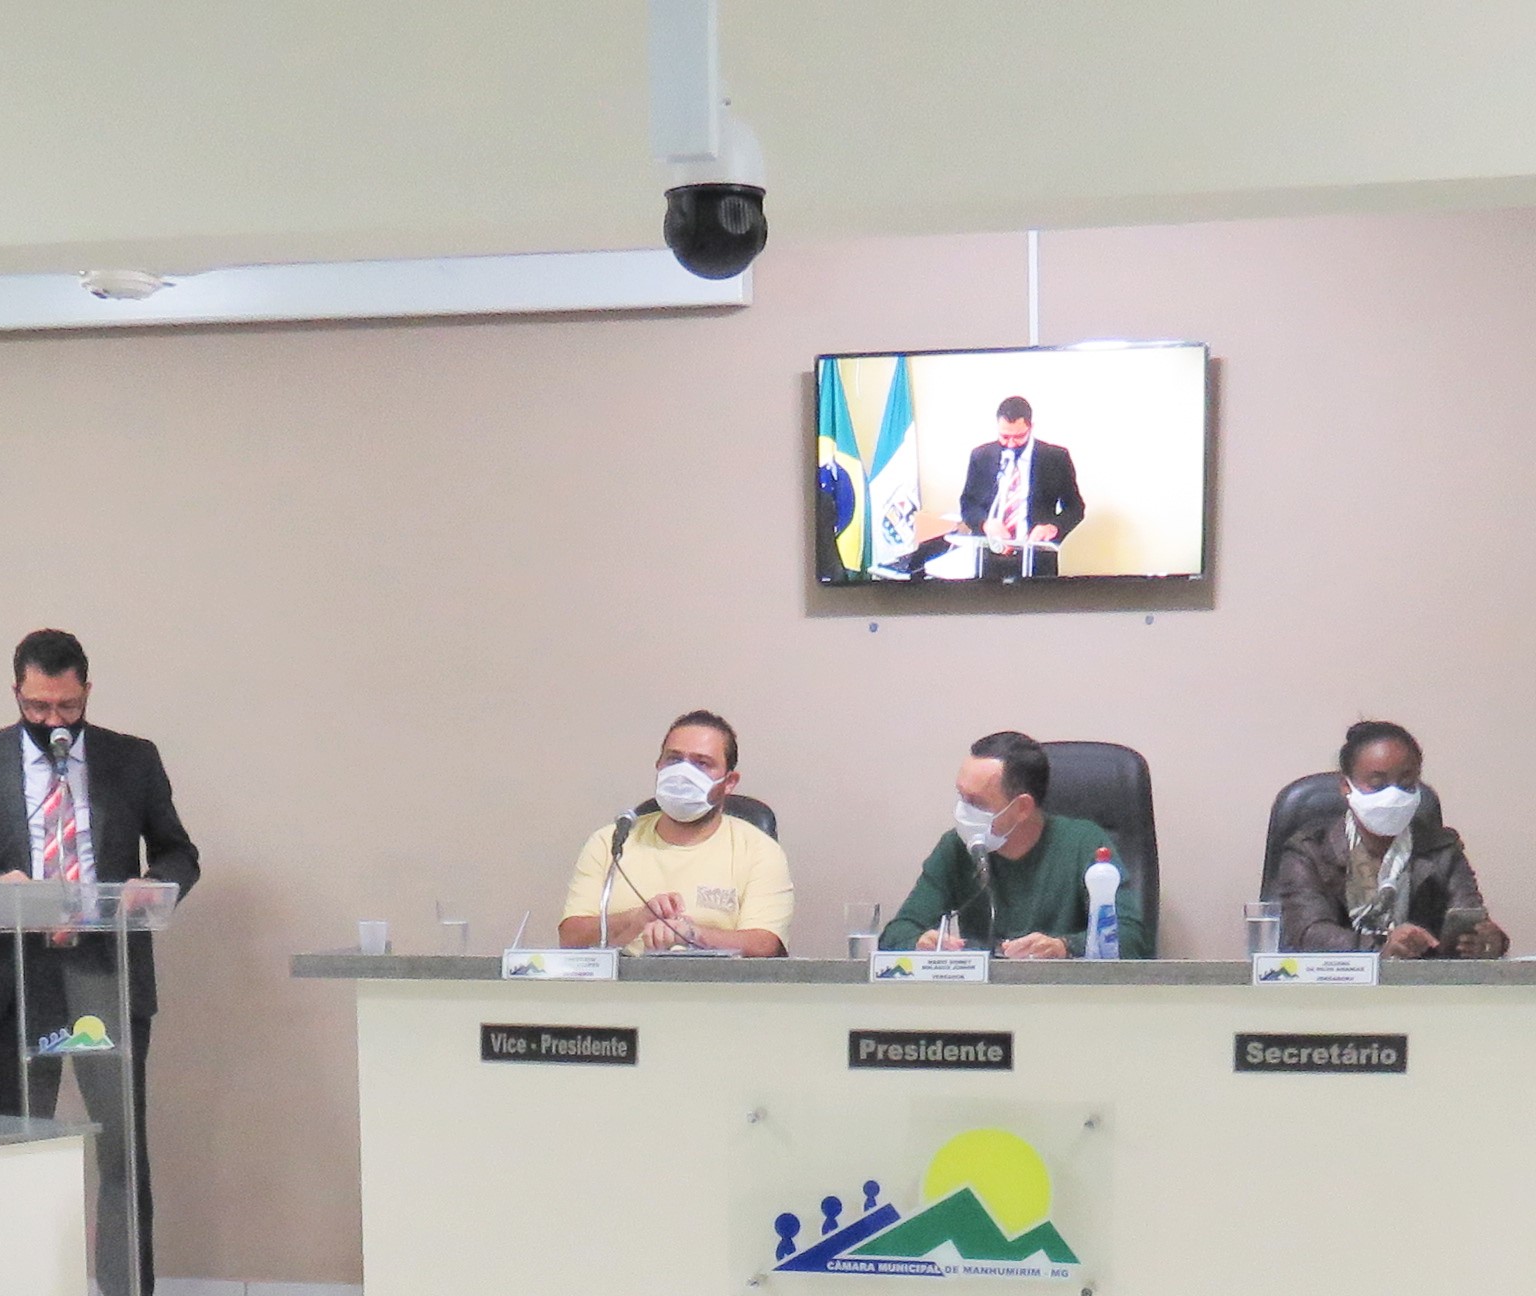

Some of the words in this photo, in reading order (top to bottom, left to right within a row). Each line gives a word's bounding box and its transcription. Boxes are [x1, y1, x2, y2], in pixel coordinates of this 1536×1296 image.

[490, 1033, 527, 1054] Vice
[540, 1033, 628, 1058] Presidente
[859, 1038, 1004, 1062] Presidente
[1245, 1041, 1397, 1065] Secretário
[826, 1260, 876, 1272] CÂMARA
[877, 1262, 942, 1275] MUNICIPAL
[945, 1265, 960, 1274] DE
[963, 1266, 1041, 1277] MANHUMIRIM
[1050, 1269, 1069, 1278] MG
